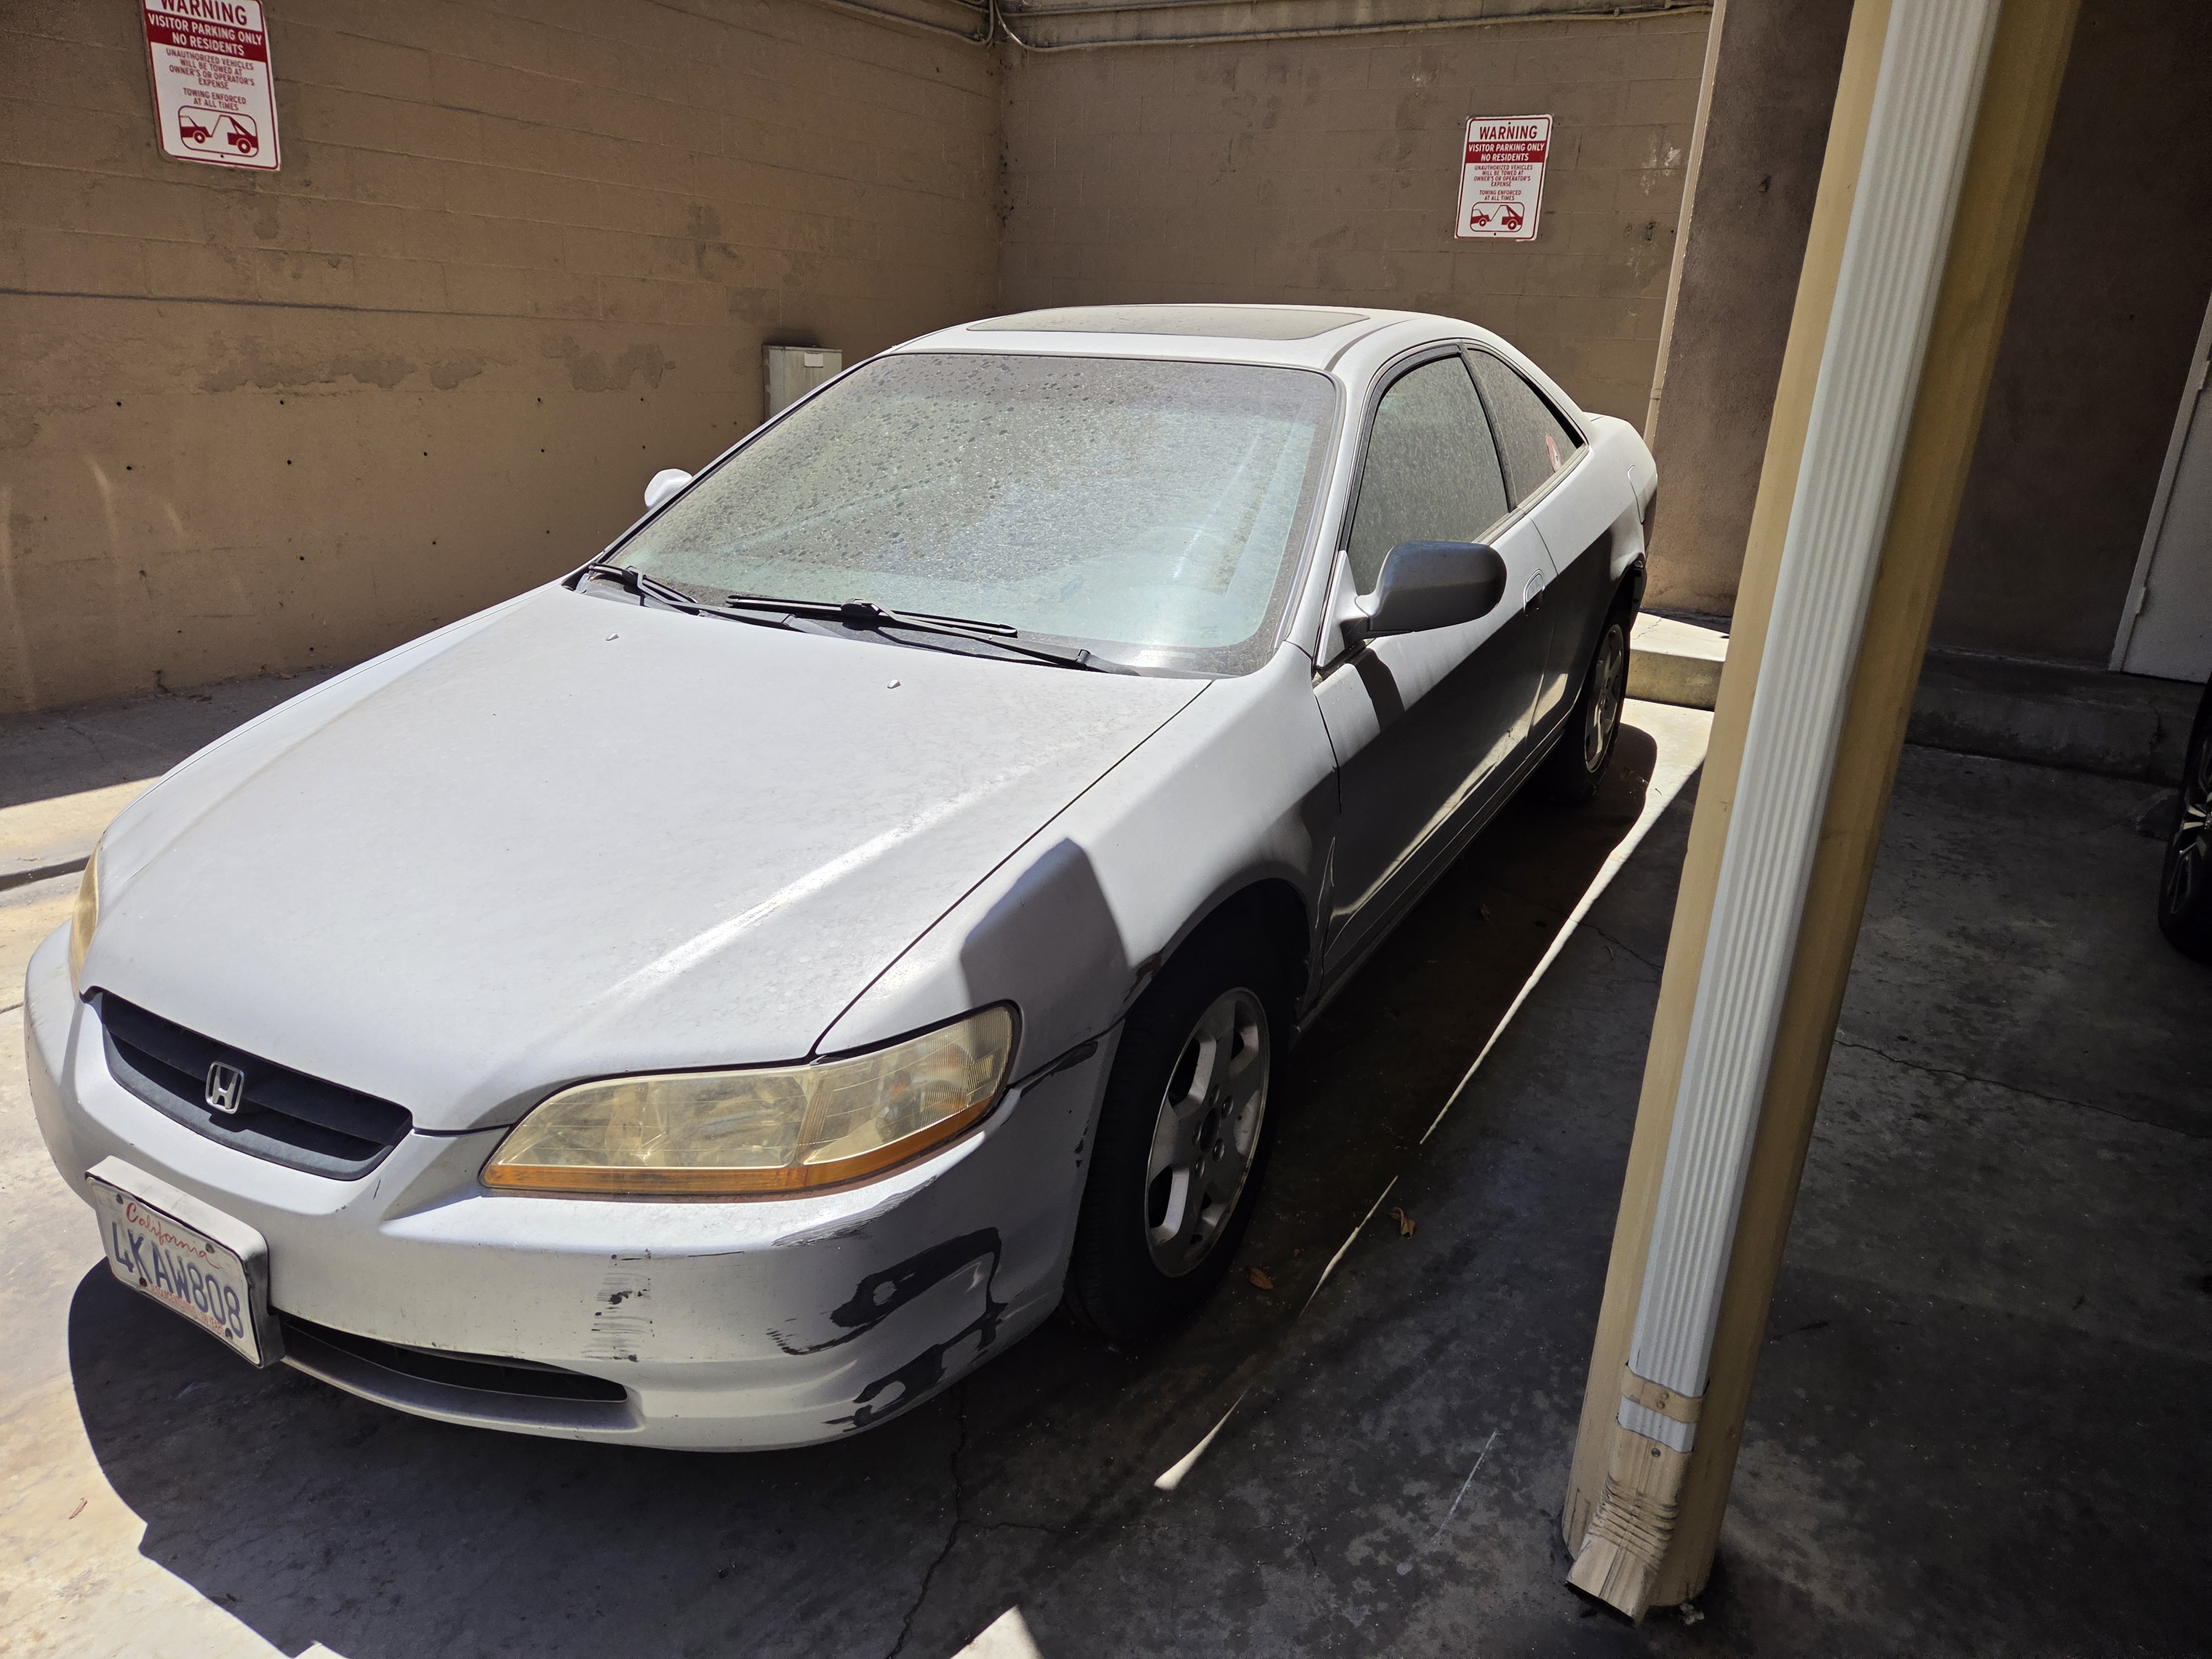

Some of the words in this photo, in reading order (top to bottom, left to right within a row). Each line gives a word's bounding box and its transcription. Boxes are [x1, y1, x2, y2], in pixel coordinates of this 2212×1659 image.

[148, 13, 189, 32] VISITOR
[191, 22, 235, 40] PARKING
[238, 31, 262, 45] ONLY
[172, 32, 186, 45] NO
[190, 35, 244, 55] RESIDENTS
[166, 48, 220, 64] UNAUTHORIZED
[221, 58, 254, 70] VEHICLES
[180, 59, 196, 68] WILL
[199, 62, 207, 70] BE
[210, 63, 232, 74] TOWED
[169, 65, 201, 77] OWNER'S
[214, 73, 255, 86] OPERATOR'S
[199, 77, 229, 90] EXPENSE
[183, 87, 210, 98] TOWING
[211, 92, 247, 105] ENFORCED
[204, 99, 217, 108] ALL
[218, 101, 239, 111] TIMES
[1480, 126, 1537, 140] WARNING
[1469, 143, 1494, 152] VISITOR
[1496, 143, 1526, 152] PARKING
[1527, 143, 1545, 152] ONLY
[1481, 153, 1491, 161] NO
[1492, 153, 1529, 161] RESIDENTS
[126, 1202, 220, 1270] California
[112, 1221, 244, 1339] 4KAW808
